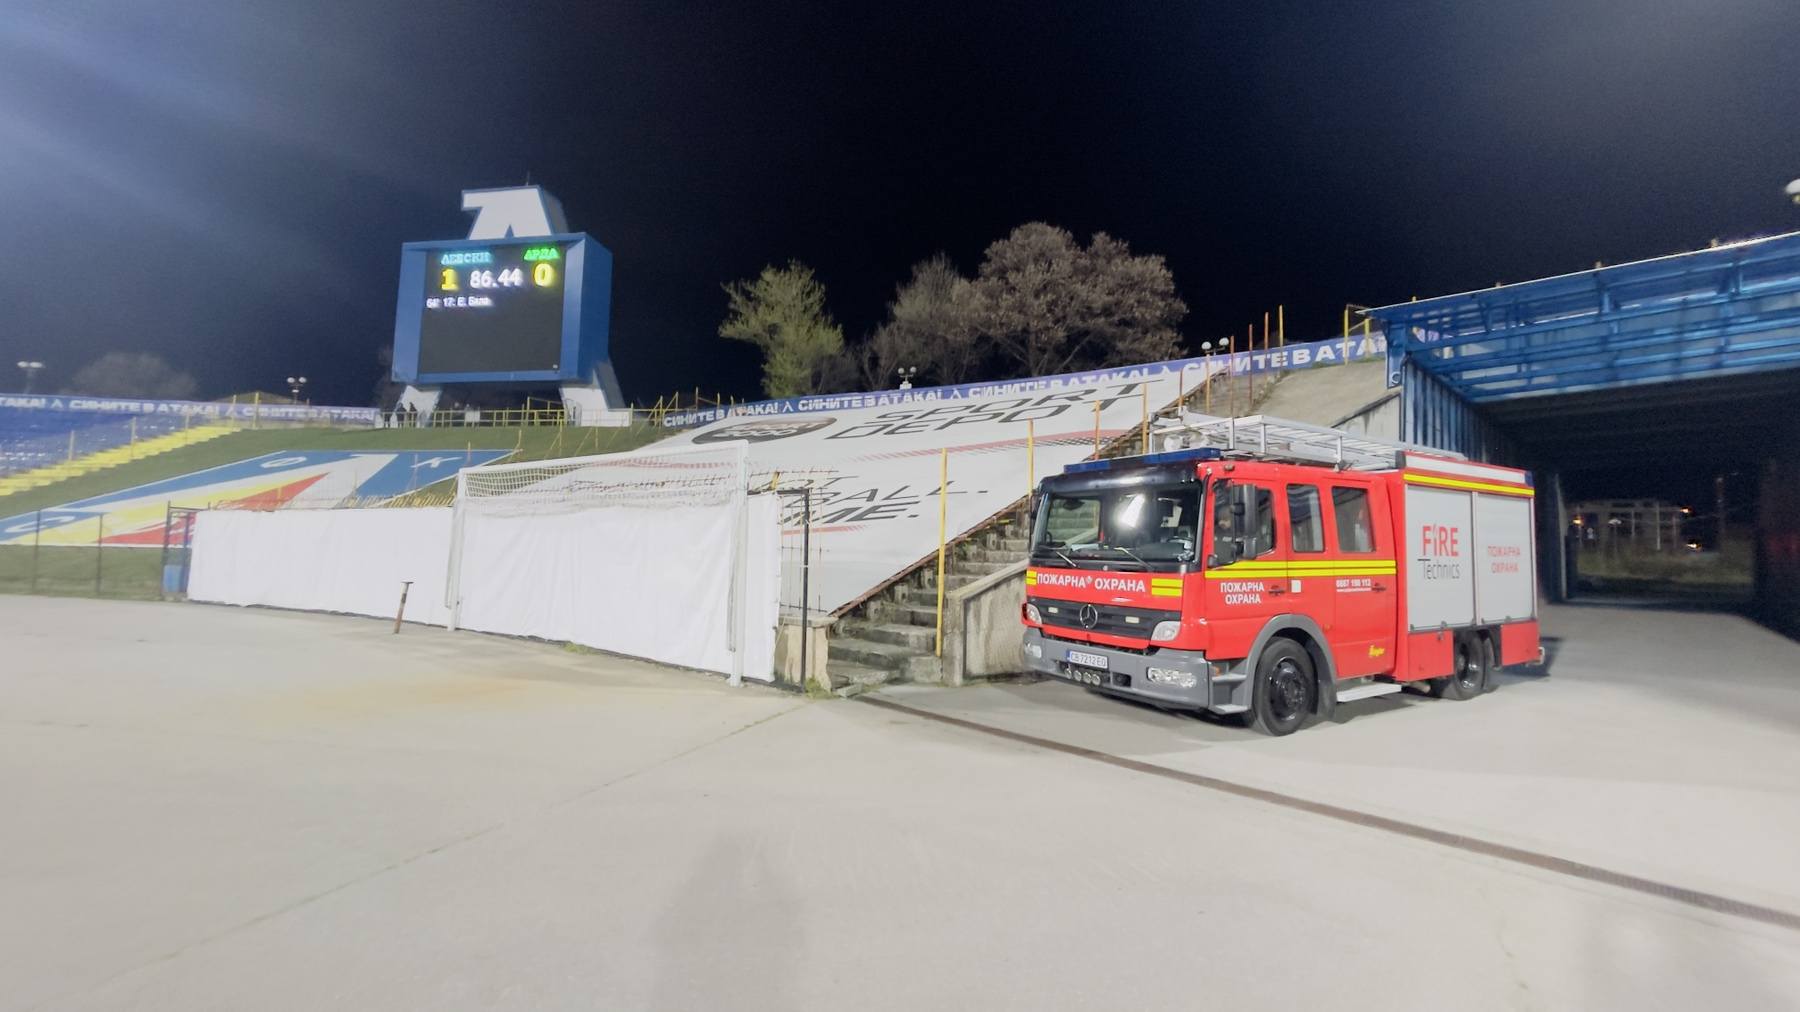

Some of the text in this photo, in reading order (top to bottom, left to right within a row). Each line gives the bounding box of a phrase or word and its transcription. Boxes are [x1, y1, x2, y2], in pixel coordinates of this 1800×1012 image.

[441, 269, 458, 290] 1
[470, 268, 522, 288] 86.44
[534, 263, 554, 287] 0
[663, 411, 715, 427] СИНИТЕ
[798, 396, 863, 411] СИНИТЕ
[875, 390, 943, 407] АТАКА!
[1292, 349, 1311, 365] В
[865, 379, 1164, 425] SPORT
[825, 393, 1145, 440] DEPOT
[1417, 558, 1460, 579] Technics
[1037, 573, 1145, 592] ПОЖАРНА ОХРАНА
[1220, 581, 1264, 593] ПОЖАРНА
[1225, 593, 1261, 604] ОХРАНА
